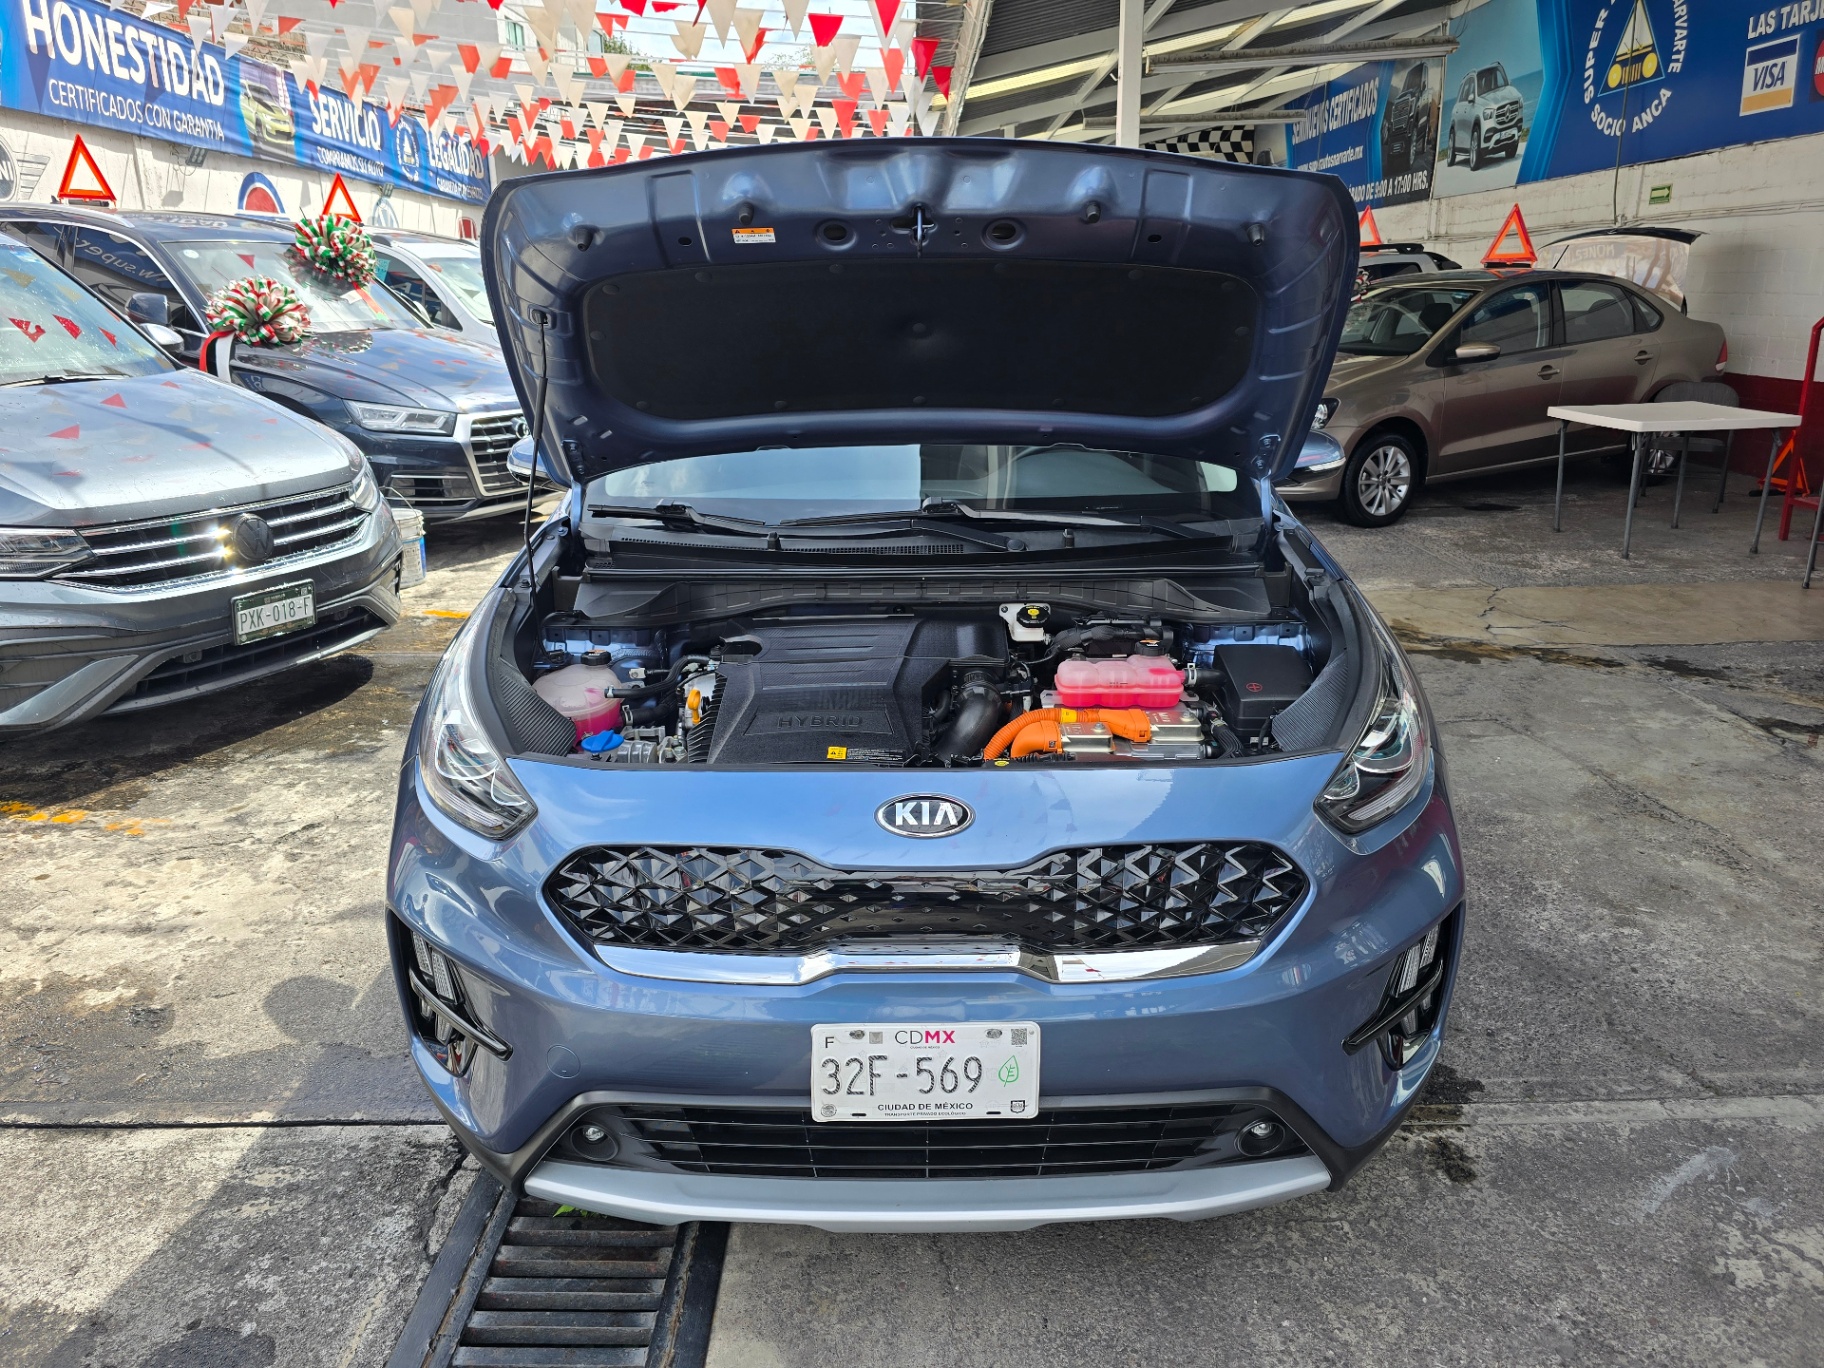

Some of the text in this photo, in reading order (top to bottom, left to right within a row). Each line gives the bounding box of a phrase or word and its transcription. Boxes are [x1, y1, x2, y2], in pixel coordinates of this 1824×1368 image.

[1668, 0, 1688, 73] ARVARTE
[1748, 10, 1776, 39] LAS
[23, 0, 225, 106] HONESTIDAD
[1584, 8, 1609, 104] SUPER
[1753, 61, 1787, 91] VISA
[49, 78, 225, 142] CERTIFICADOS CON GARANTIA
[309, 93, 382, 151] SERVICIO
[1328, 77, 1379, 132] CERTIFICADOS
[1591, 88, 1672, 137] SOCIO ANCA
[426, 131, 485, 180] LEGALIDAD
[1349, 184, 1366, 202] ÁBADO
[1366, 182, 1375, 201] DE
[1375, 180, 1388, 199] 9:00
[1387, 178, 1393, 197] A
[1394, 174, 1411, 195] 17:00
[240, 596, 311, 632] PXK-018-F
[777, 715, 863, 729] HYBRID
[895, 801, 958, 826] KIA
[825, 1036, 835, 1049] F
[894, 1030, 956, 1045] CDMX
[820, 1054, 983, 1097] 32F-569
[877, 1101, 974, 1112] CIUDAD DE MÉXICO
